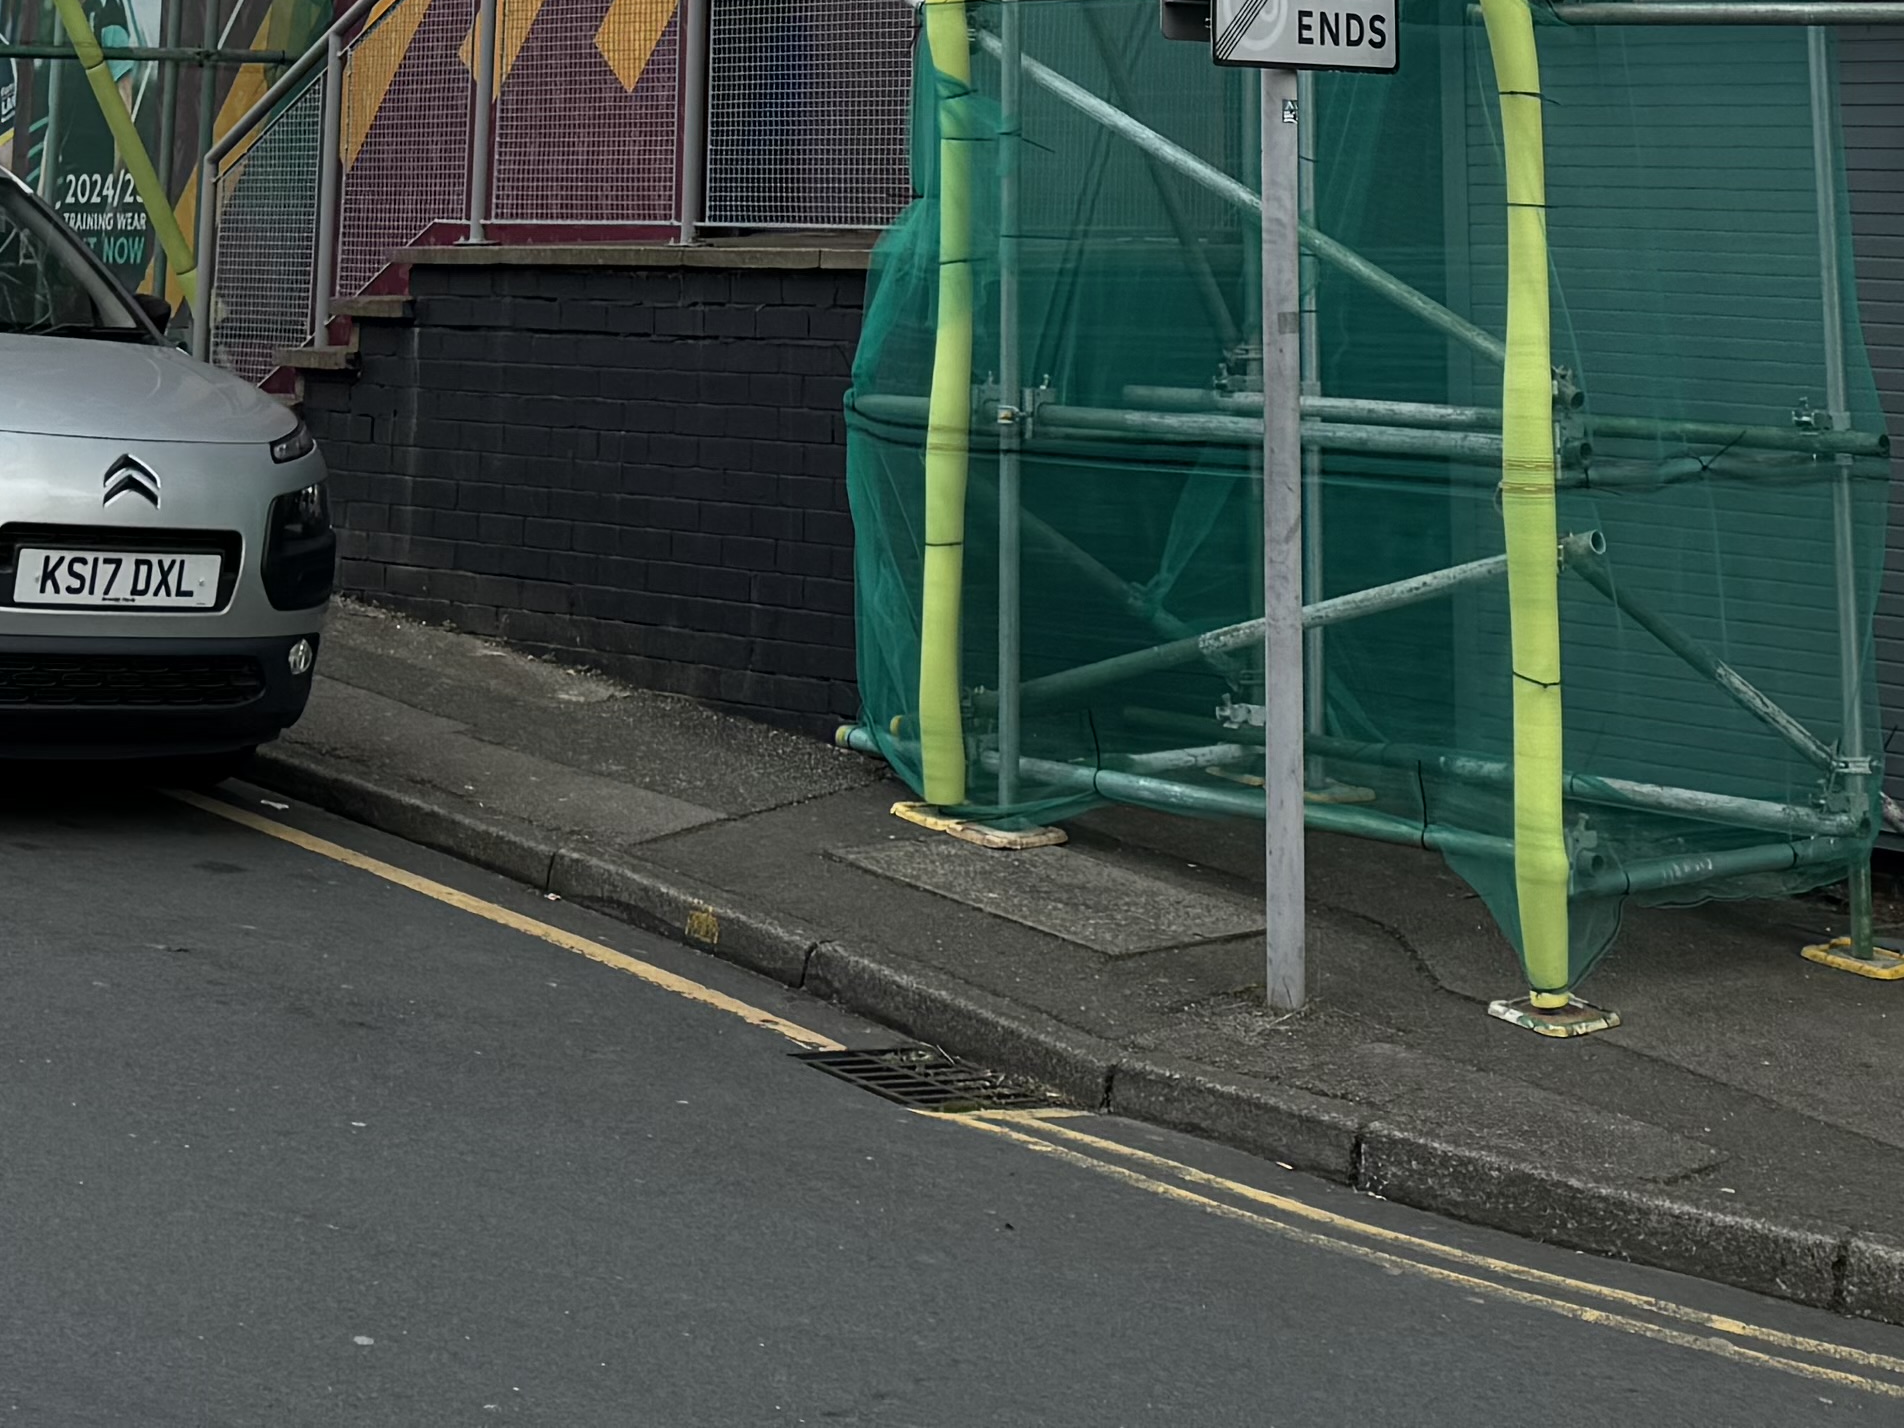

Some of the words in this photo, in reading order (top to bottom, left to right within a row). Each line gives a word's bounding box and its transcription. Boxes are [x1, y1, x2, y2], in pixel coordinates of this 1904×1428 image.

[1297, 9, 1387, 50] ENDS
[65, 169, 144, 207] 2024/2
[116, 212, 147, 230] WEAR
[103, 236, 145, 264] NOW
[39, 555, 123, 596] KS17
[130, 558, 194, 598] DXL
